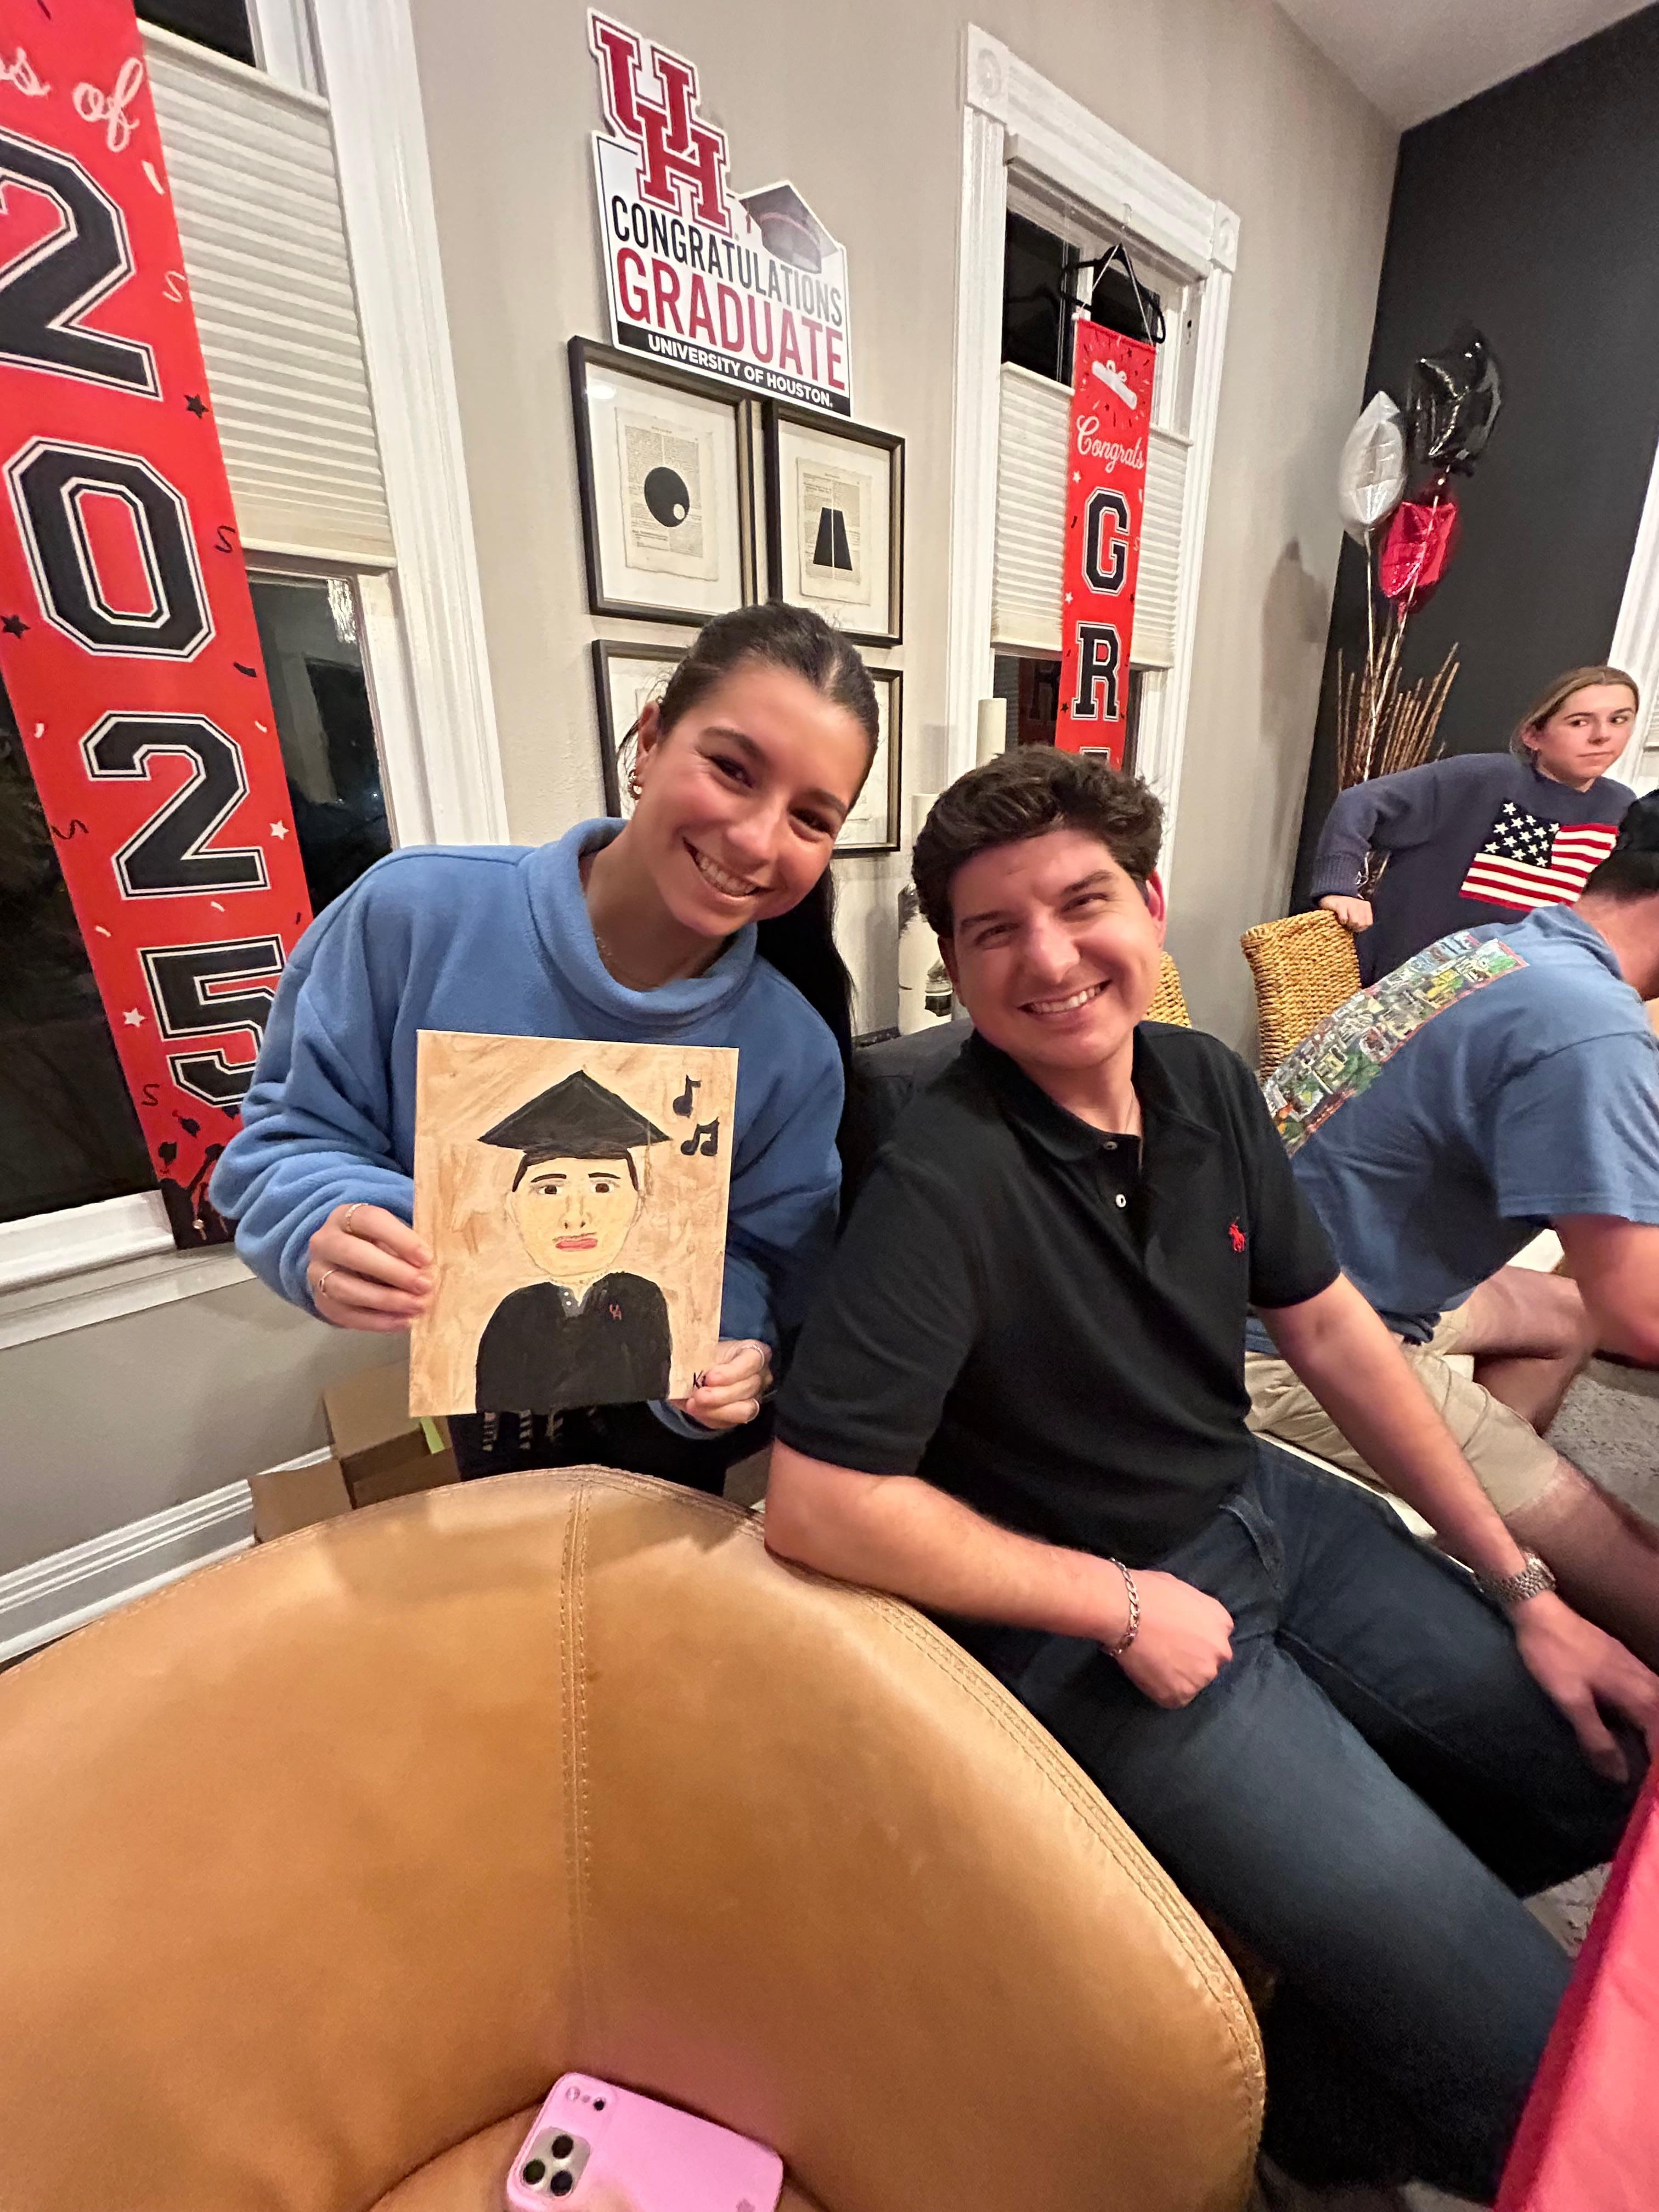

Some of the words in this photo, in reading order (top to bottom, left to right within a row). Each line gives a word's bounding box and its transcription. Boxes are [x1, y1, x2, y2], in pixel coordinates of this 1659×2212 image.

[72, 57, 144, 153] of
[592, 15, 732, 239] UH
[612, 195, 843, 328] CONGRATULATIONS
[616, 247, 845, 391] GRADUATE
[648, 334, 741, 377] UNIVERSITY
[744, 365, 764, 383] OF
[1076, 415, 1145, 473] Congrats
